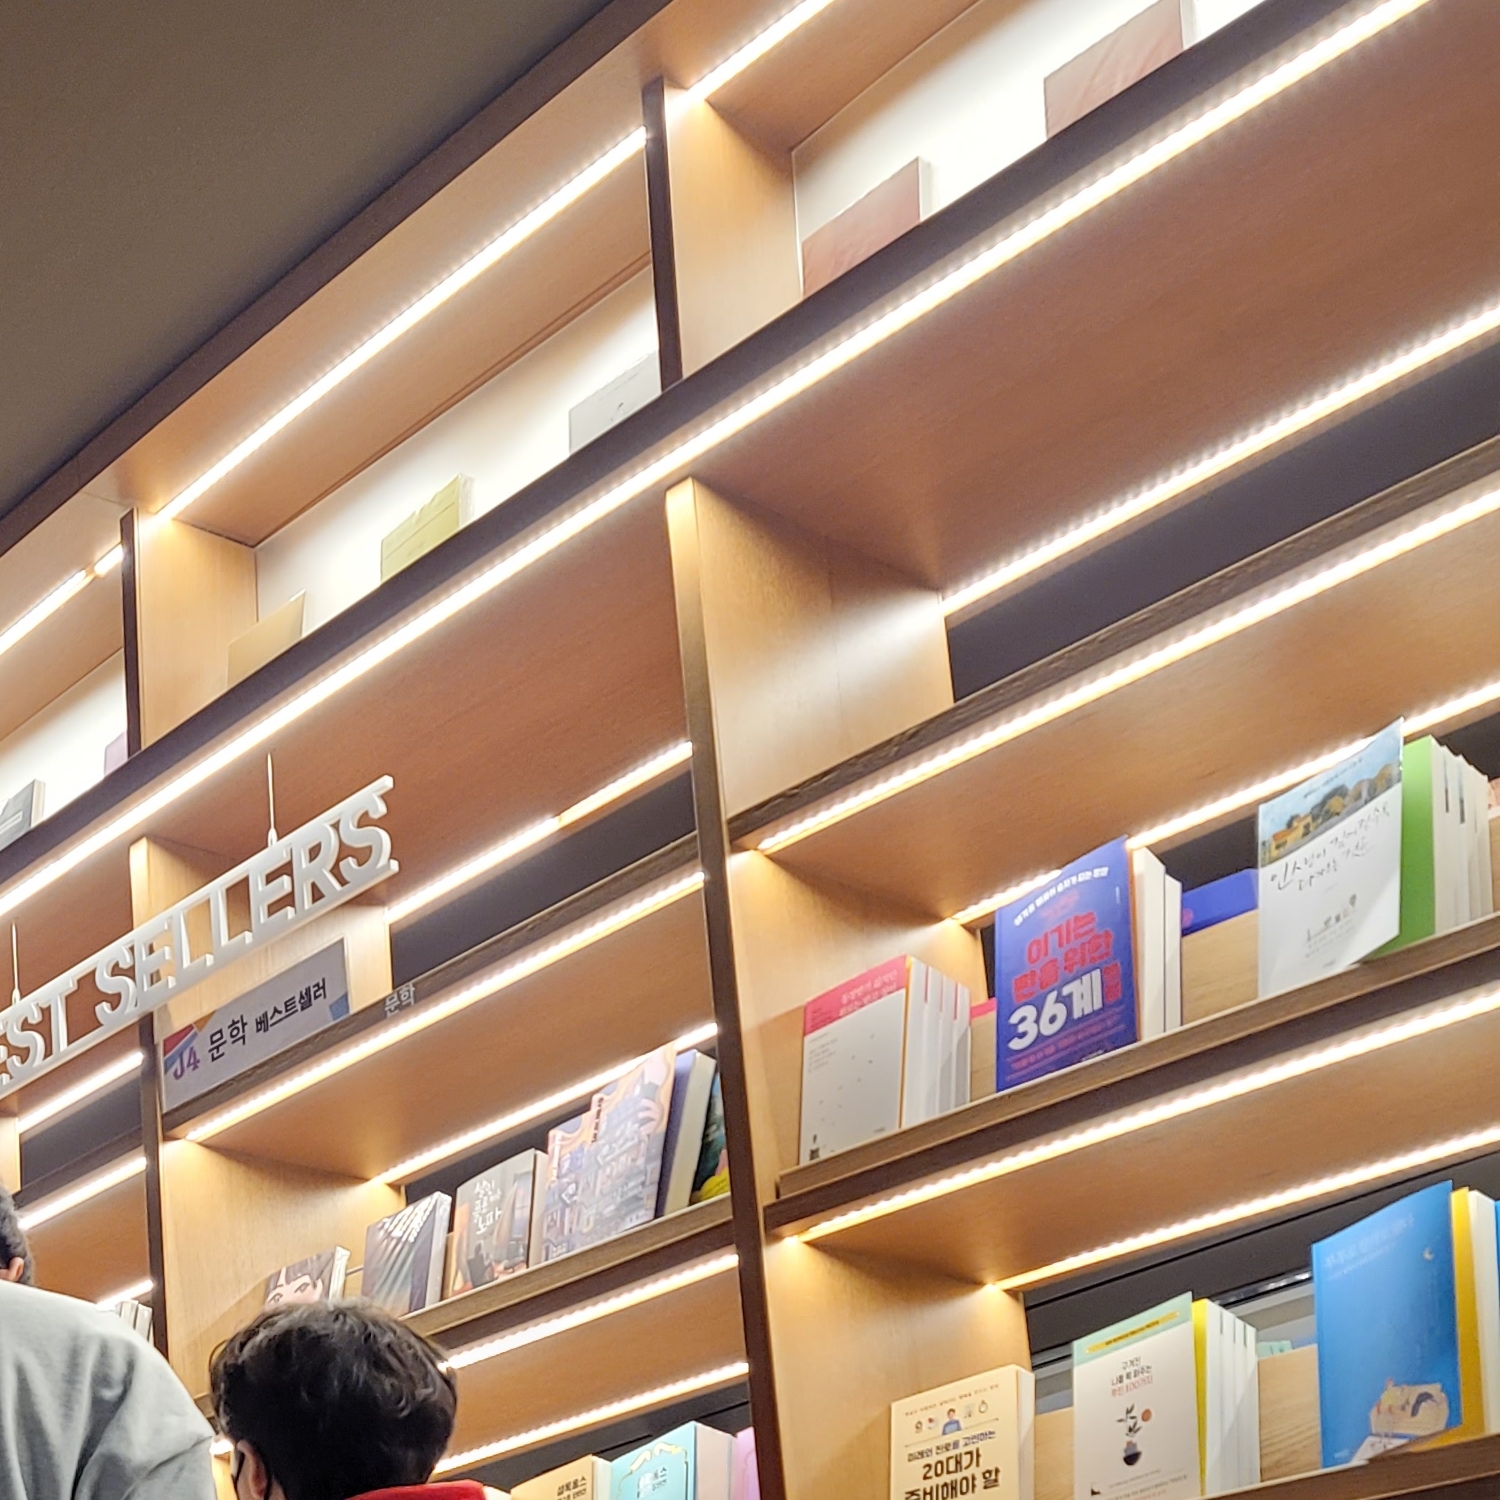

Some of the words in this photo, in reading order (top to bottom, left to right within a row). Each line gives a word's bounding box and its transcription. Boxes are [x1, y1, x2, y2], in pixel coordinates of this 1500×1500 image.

[93, 775, 399, 1028] SELLERS
[1027, 911, 1097, 965] 이기는
[1063, 929, 1114, 974] 위한
[384, 983, 416, 1017] 문학
[1008, 968, 1104, 1051] 36계
[172, 1046, 200, 1080] J4
[208, 1014, 248, 1063] 문학
[255, 977, 327, 1033] 베스트셀러
[907, 1447, 933, 1462] 미래와
[935, 1439, 960, 1455] 진로를
[962, 1430, 996, 1447] 고민하는
[922, 1447, 982, 1481] 20대가
[981, 1466, 1001, 1490] 할
